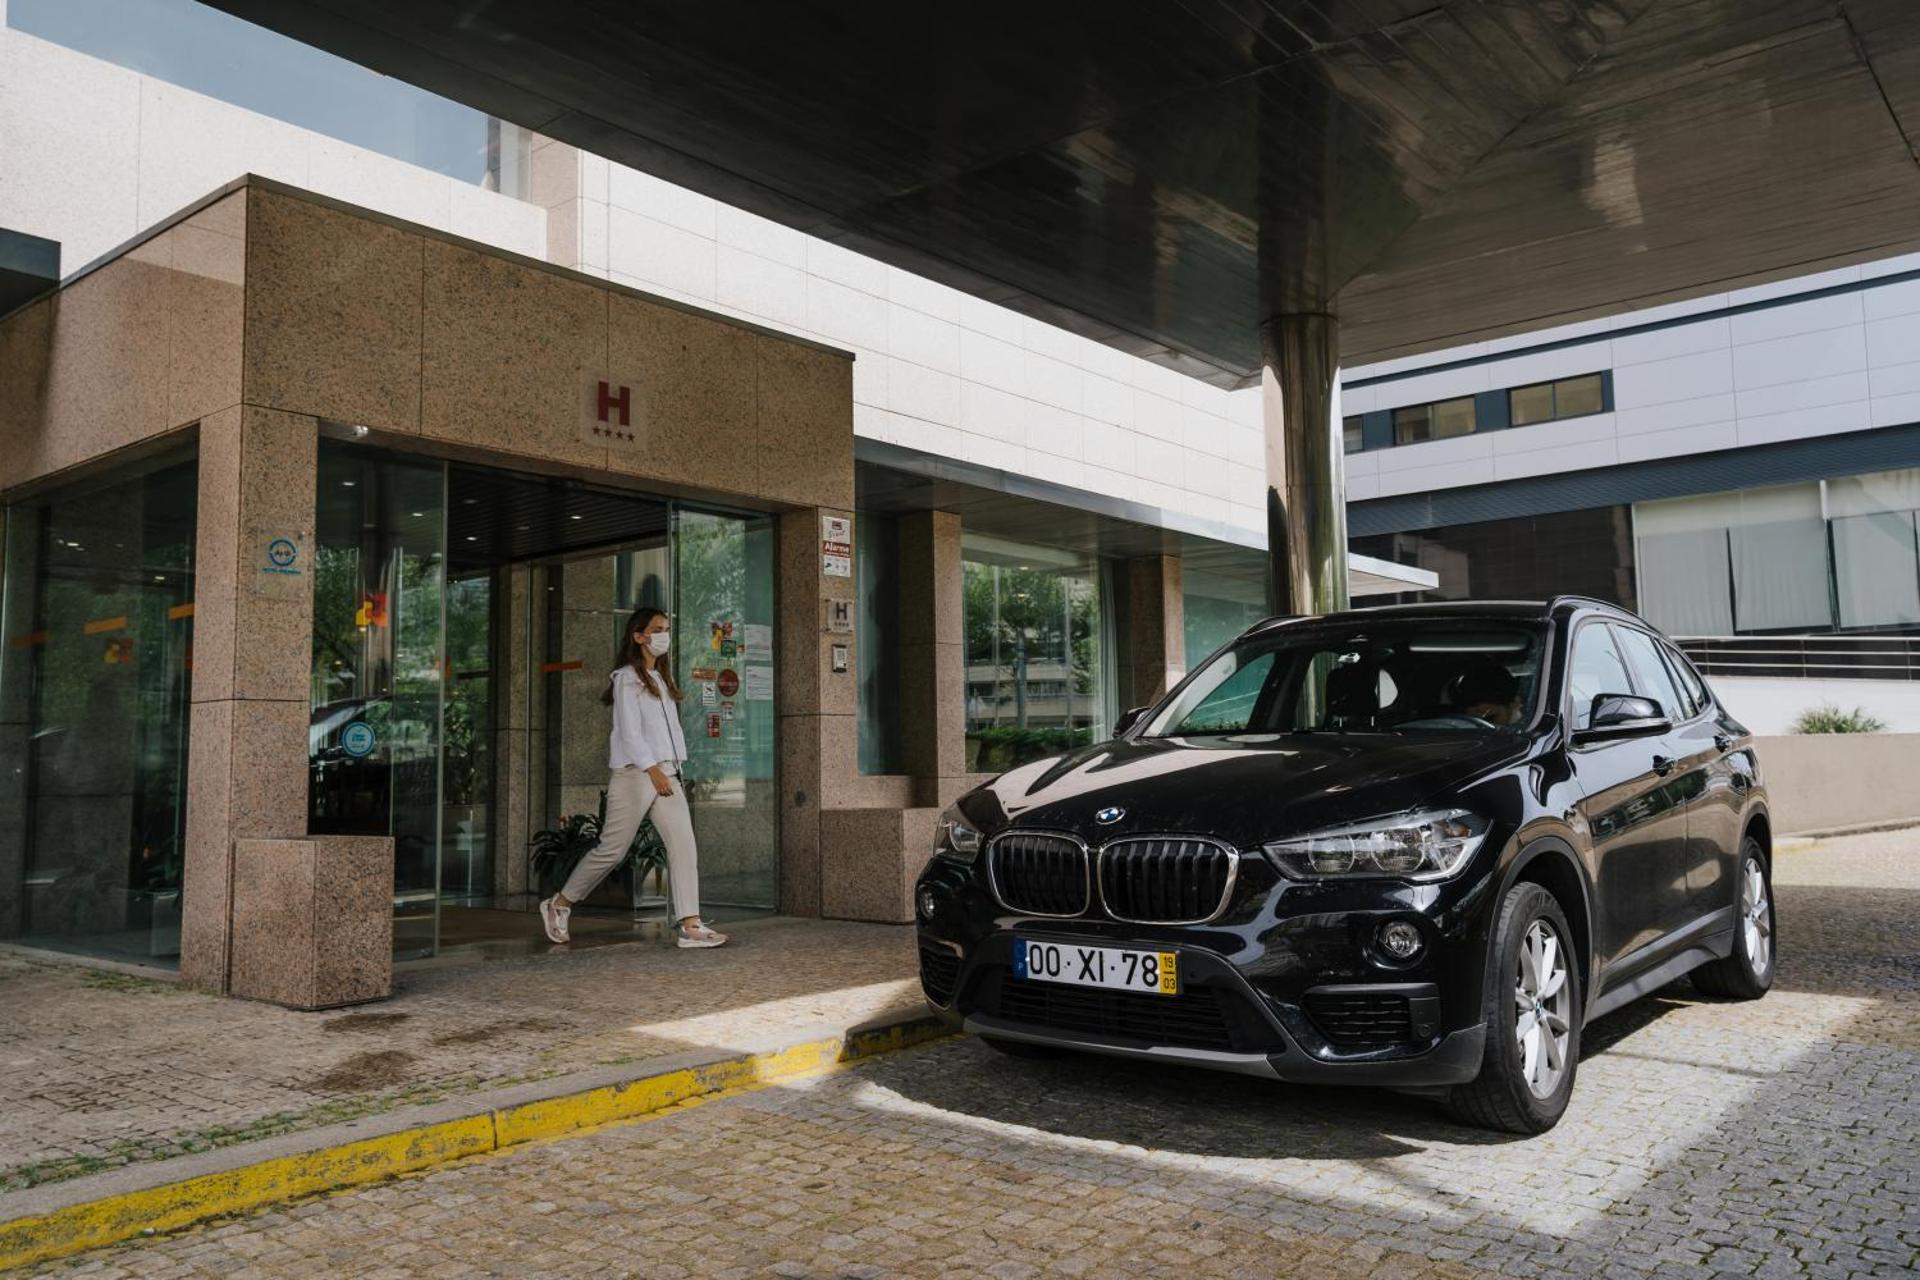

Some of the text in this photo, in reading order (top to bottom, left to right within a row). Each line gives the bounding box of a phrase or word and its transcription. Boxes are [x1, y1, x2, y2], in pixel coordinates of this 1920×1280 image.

[598, 381, 630, 426] H
[836, 602, 848, 620] H
[1163, 978, 1176, 990] 03
